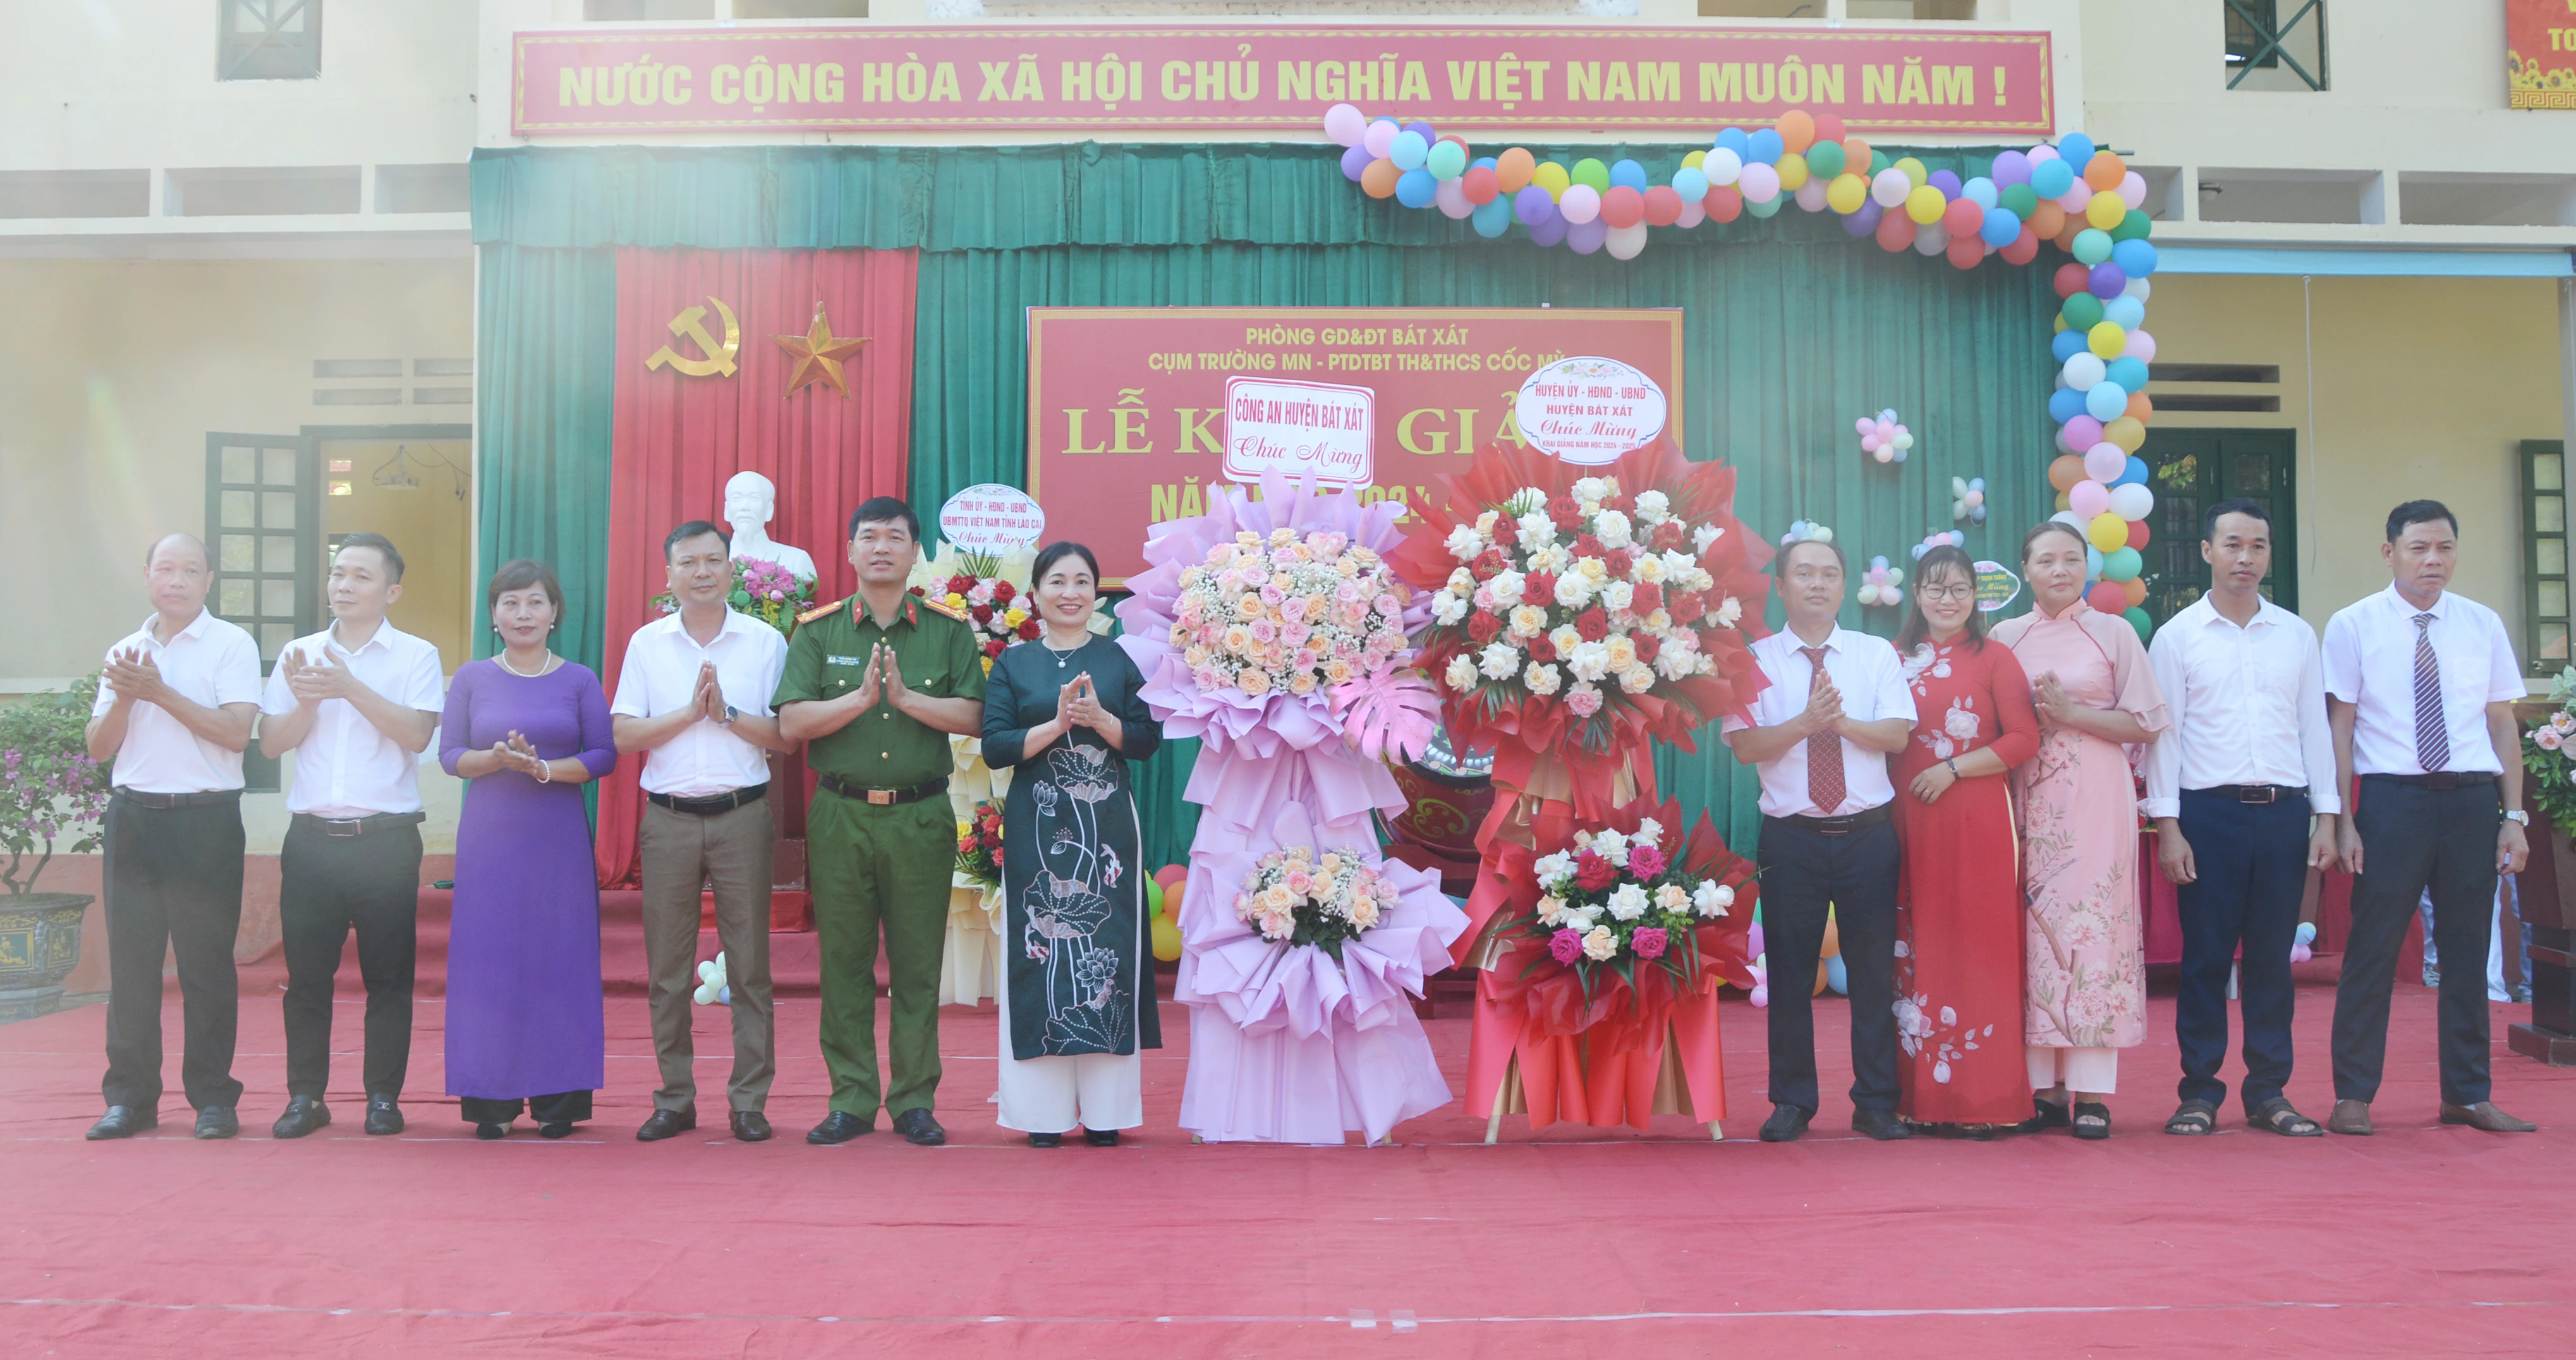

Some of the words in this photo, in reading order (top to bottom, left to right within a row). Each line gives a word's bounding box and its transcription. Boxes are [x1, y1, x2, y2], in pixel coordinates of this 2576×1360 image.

[559, 54, 692, 106] NƯỚC
[710, 56, 844, 112] CỘNG
[863, 52, 962, 102] HÒA
[978, 53, 1044, 101] XÃ
[1062, 51, 1143, 110] HỘI
[1161, 43, 1260, 101] CHỦ
[1277, 52, 1431, 102] NGHĨA
[1447, 51, 1550, 110] VIỆT
[1567, 61, 1681, 101] NAM
[1699, 54, 1845, 104] MUÔN
[1862, 56, 1974, 105] NĂM
[1994, 66, 2008, 105] !
[1246, 323, 1316, 345] PHÒNG
[1321, 328, 1387, 345] GD&ĐT
[1393, 324, 1426, 345] BÁT
[1432, 324, 1469, 345] XÁT
[1148, 353, 1193, 374] CỤM
[1198, 348, 1276, 370] TRƯỜNG
[1282, 353, 1311, 370] MN
[1328, 353, 1392, 371] PTDTBT
[1397, 353, 1481, 371] TH&THCS
[1486, 346, 1531, 371] CỐC
[1535, 382, 1565, 400] HUYỆN
[1567, 380, 1579, 398] ỦY
[1588, 386, 1612, 399] HĐND
[1621, 387, 1646, 399] UBND
[1235, 393, 1264, 423] CÔNG
[1267, 400, 1282, 424] AN
[1284, 398, 1319, 432] HUYỆN
[1321, 400, 1342, 429] BÁT
[1344, 402, 1364, 431] XÁT
[1546, 403, 1584, 417] HUYỆN
[1587, 403, 1609, 416] BÁT
[1612, 404, 1633, 416] XÁT
[1061, 388, 1153, 454] LỄ
[1541, 419, 1583, 435] Chúc
[1585, 420, 1637, 440] Mừng
[1557, 437, 1574, 447] GIẢNG
[1576, 440, 1589, 448] NĂM
[1590, 441, 1602, 450] HỌC
[1233, 435, 1287, 459] Chúc
[1296, 441, 1363, 474] Mừng
[960, 497, 974, 511] TỈNH
[975, 497, 983, 511] ỦY
[988, 501, 1005, 513] HĐND
[1011, 502, 1027, 513] UBND
[943, 515, 968, 527] UBMTTQ
[970, 514, 984, 529] VIỆT
[985, 517, 1000, 528] NAM
[1002, 514, 1016, 528] TỈNH
[1018, 516, 1030, 529] LÀO
[1031, 519, 1042, 529] CAI
[959, 531, 988, 543] Chúc
